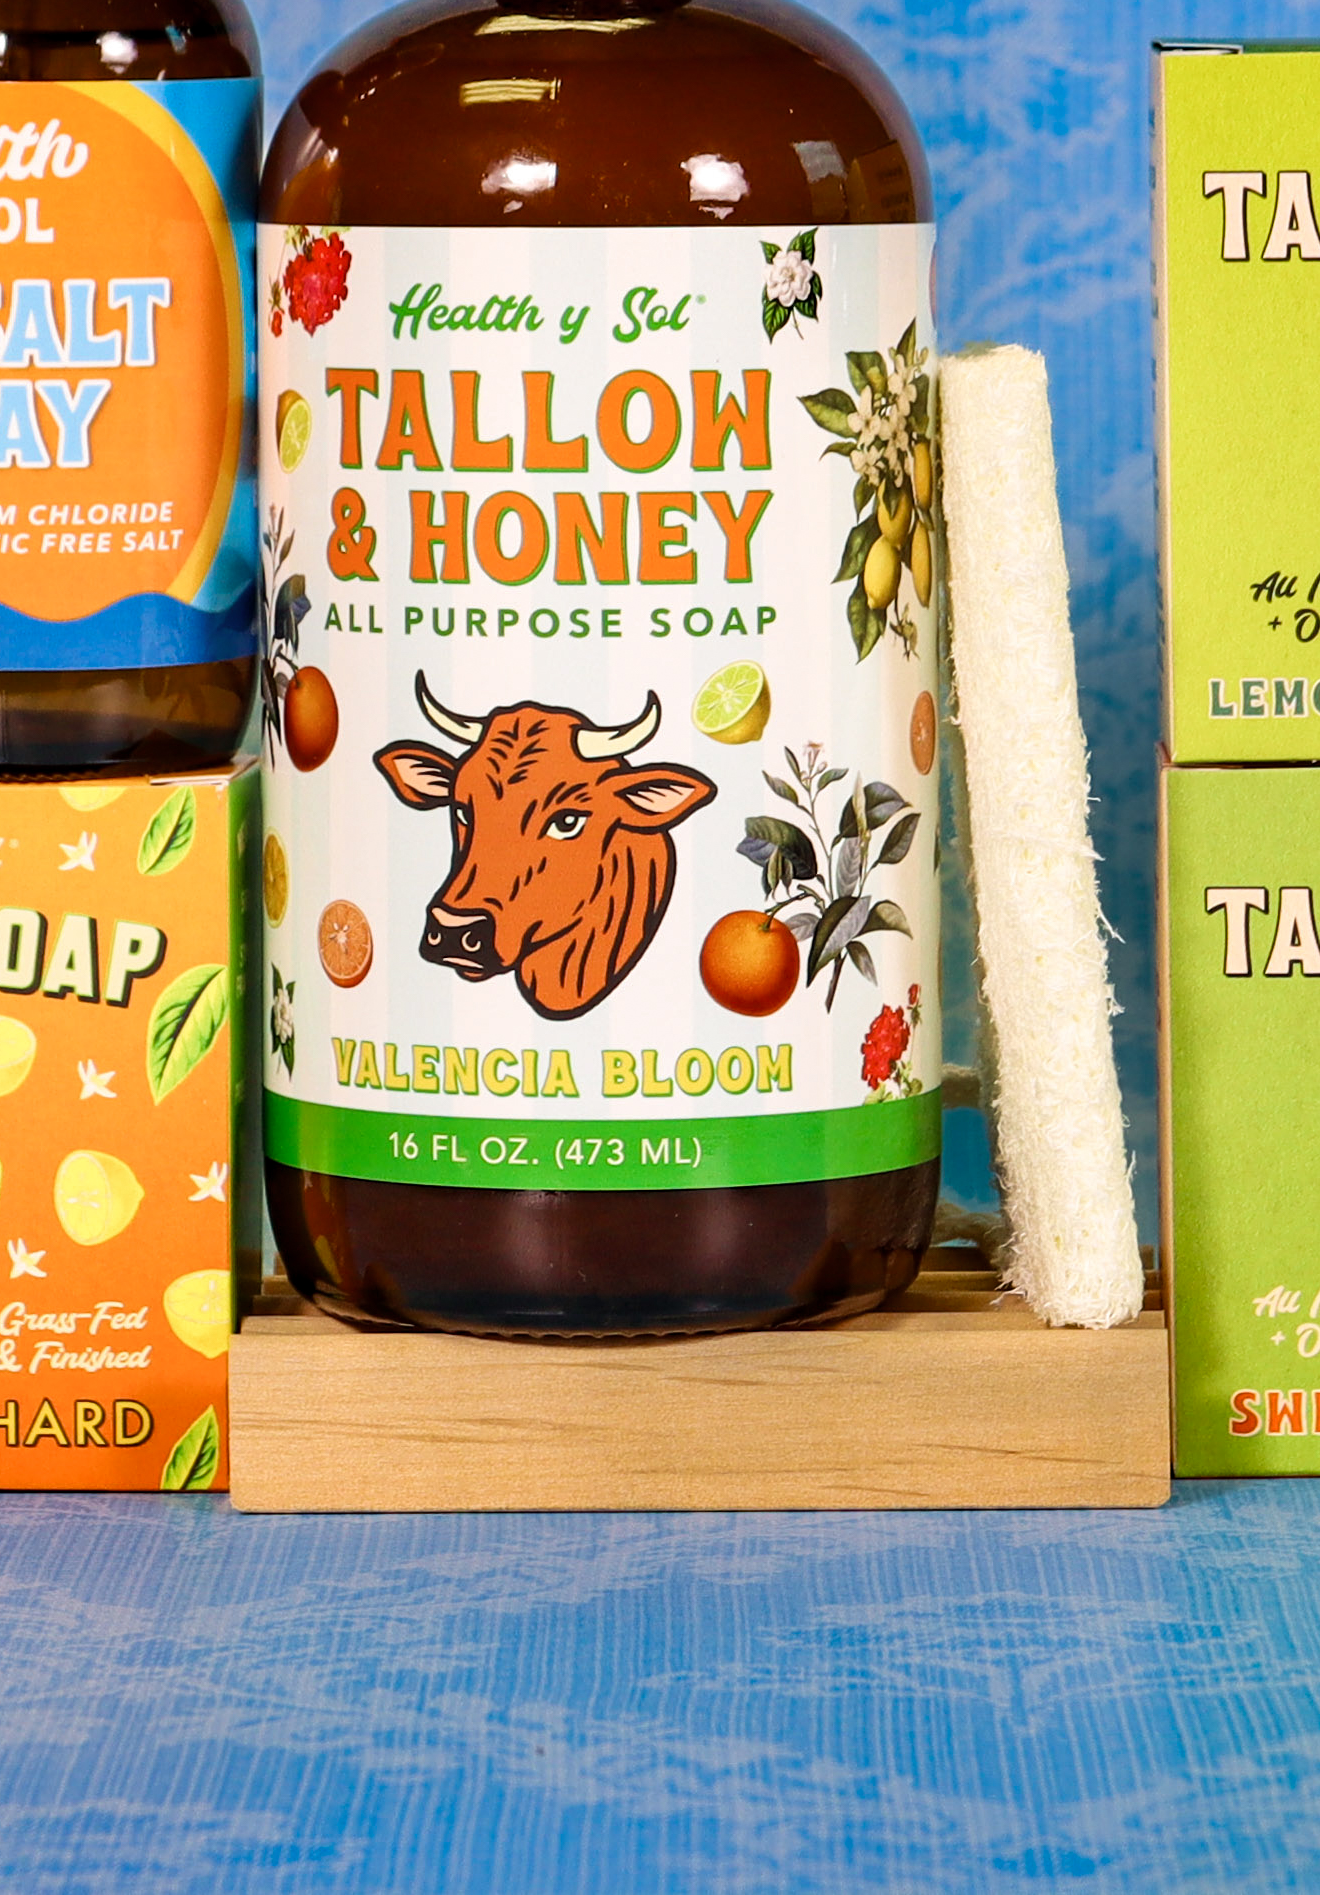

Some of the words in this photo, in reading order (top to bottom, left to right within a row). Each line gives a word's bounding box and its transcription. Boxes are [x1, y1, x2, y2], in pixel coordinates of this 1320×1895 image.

[389, 283, 544, 340] Health
[559, 304, 590, 344] y
[325, 367, 772, 473] TALLOW
[28, 502, 173, 525] CHLORIDE
[41, 533, 111, 553] FREE
[122, 529, 183, 552] SALT
[326, 486, 379, 582] &
[408, 489, 773, 586] HONEY
[1251, 572, 1296, 602] All
[324, 603, 383, 635] ALL
[404, 605, 622, 639] PURPOSE
[649, 605, 778, 638] SOAP
[1268, 616, 1282, 633] +
[331, 1037, 580, 1098] VALENCIA
[602, 1044, 793, 1098] BLOOM
[388, 1132, 419, 1161] 16
[432, 1136, 467, 1163] FL
[480, 1137, 539, 1166] OZ.
[554, 1138, 626, 1170] (473
[641, 1137, 703, 1168] ML)
[1252, 1286, 1299, 1316] All
[1269, 1331, 1285, 1347] +
[29, 1340, 151, 1374] Finished
